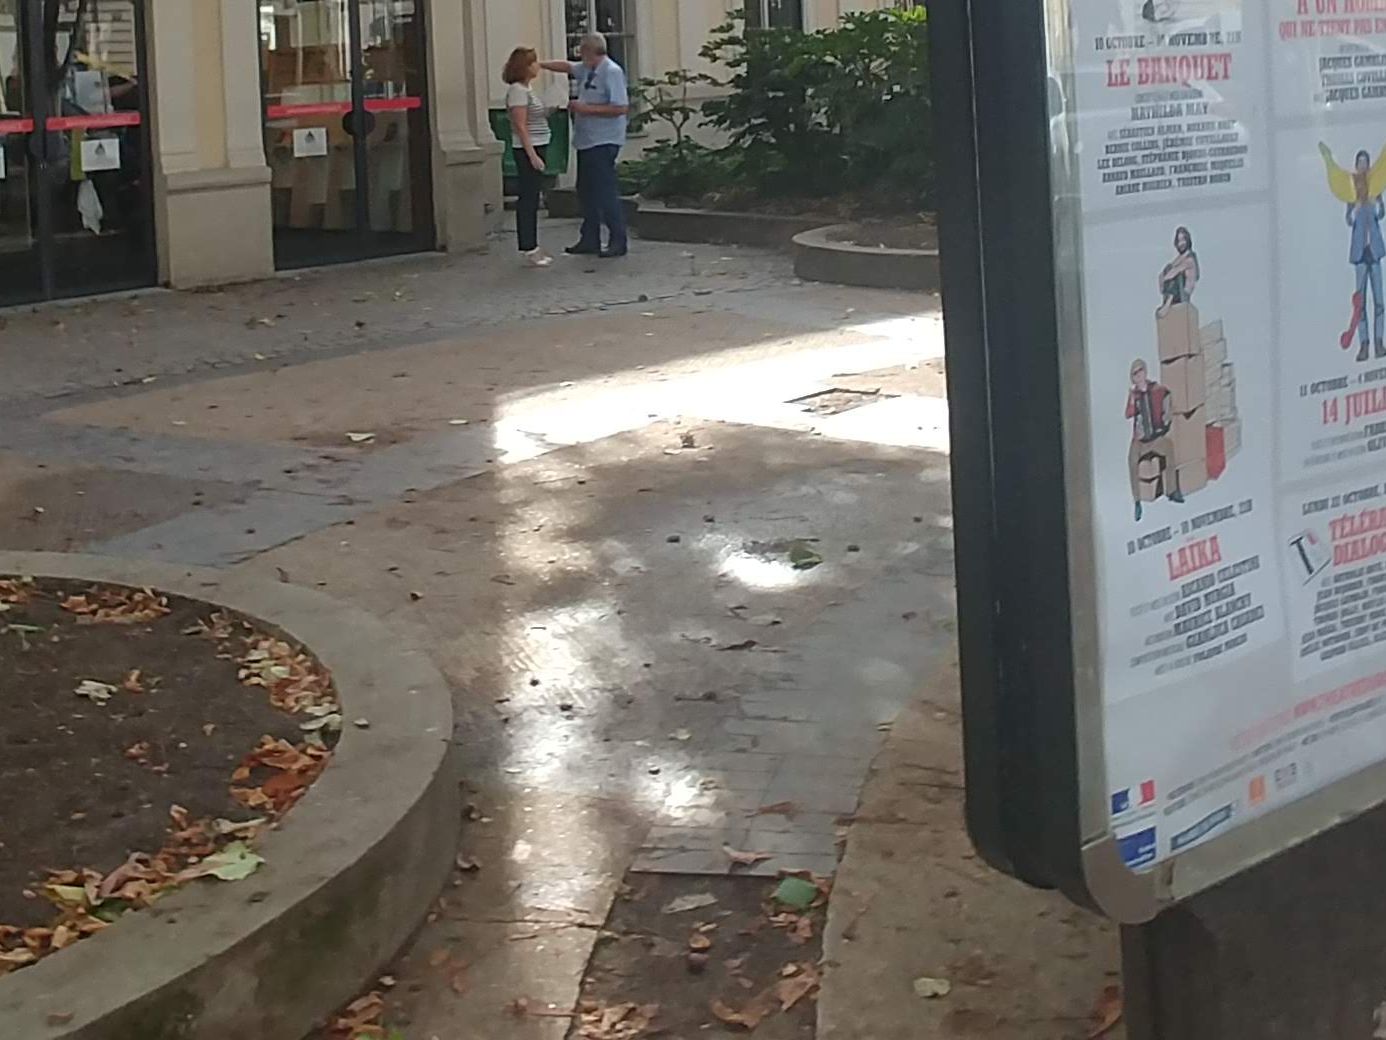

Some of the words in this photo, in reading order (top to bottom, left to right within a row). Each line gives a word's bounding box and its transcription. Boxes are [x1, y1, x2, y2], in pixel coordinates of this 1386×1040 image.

[1106, 58, 1131, 88] LE
[1137, 52, 1232, 88] BANQUET
[1322, 396, 1339, 425] 14
